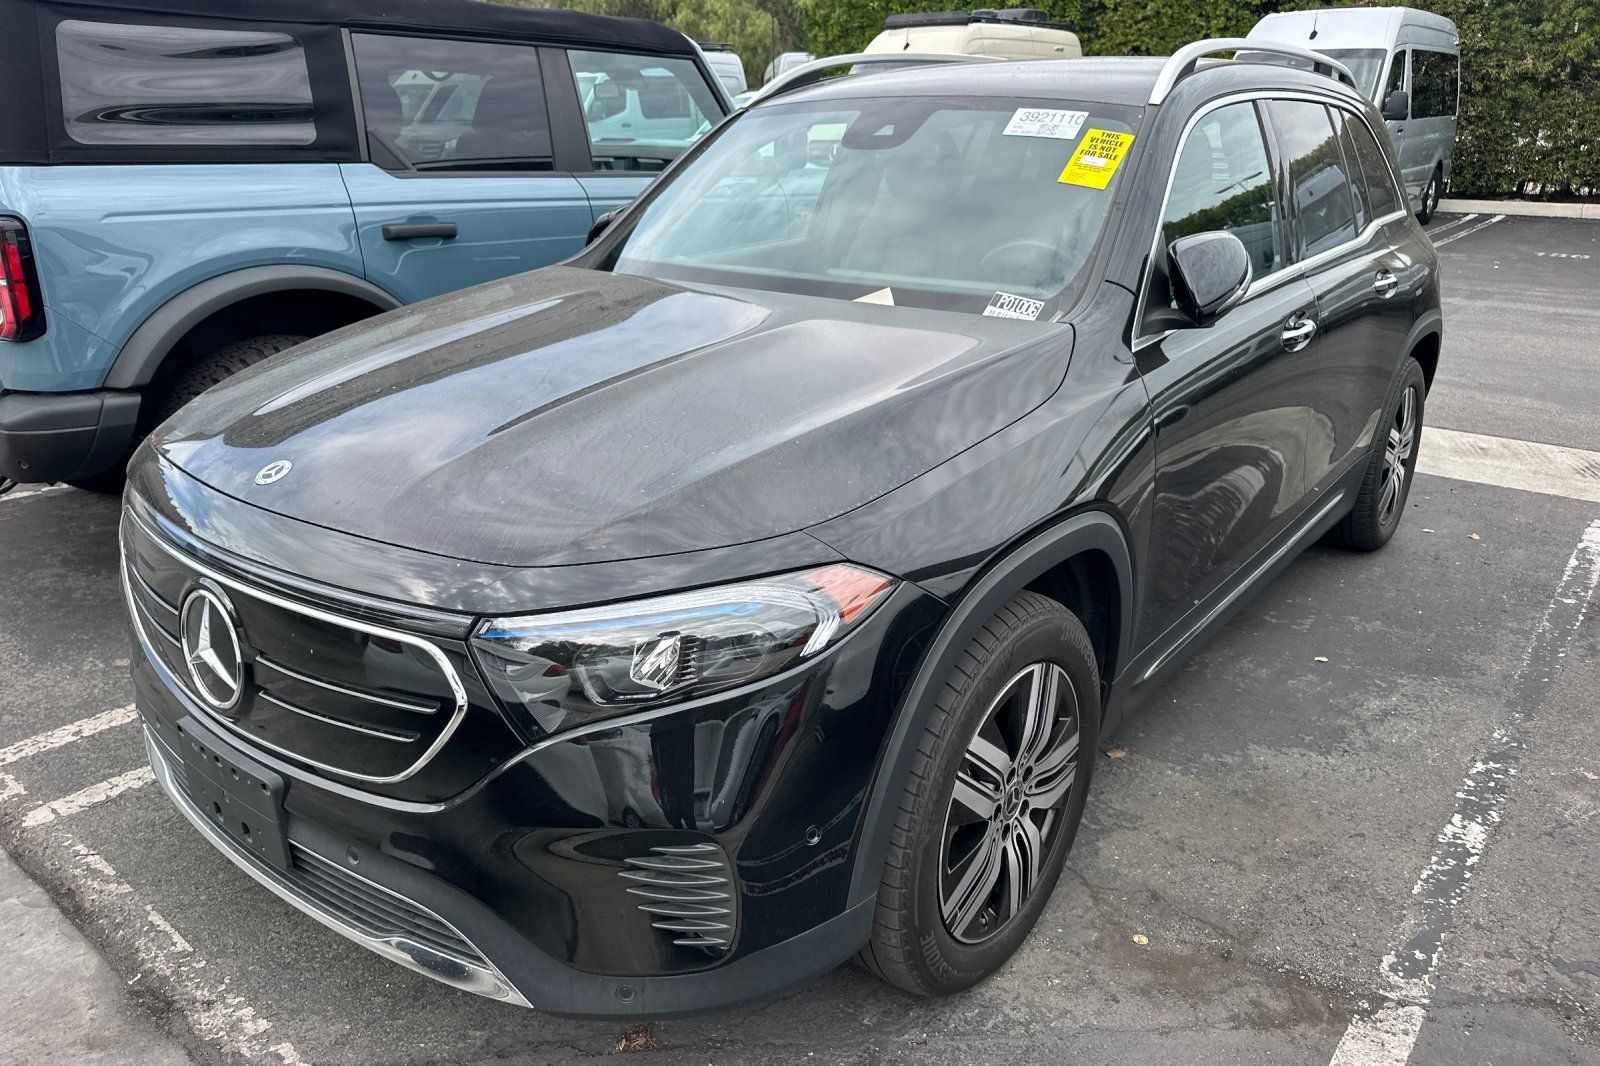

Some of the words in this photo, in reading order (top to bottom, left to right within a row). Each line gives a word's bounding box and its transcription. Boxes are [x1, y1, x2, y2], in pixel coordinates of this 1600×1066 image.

[1019, 111, 1085, 126] 3921110
[1101, 131, 1121, 140] THIS
[1090, 137, 1125, 148] VEHICLE
[1088, 143, 1099, 151] IS
[1099, 145, 1118, 154] NOT
[1080, 149, 1096, 158] FOR
[1097, 152, 1119, 161] SALE
[996, 295, 1041, 317] P01006
